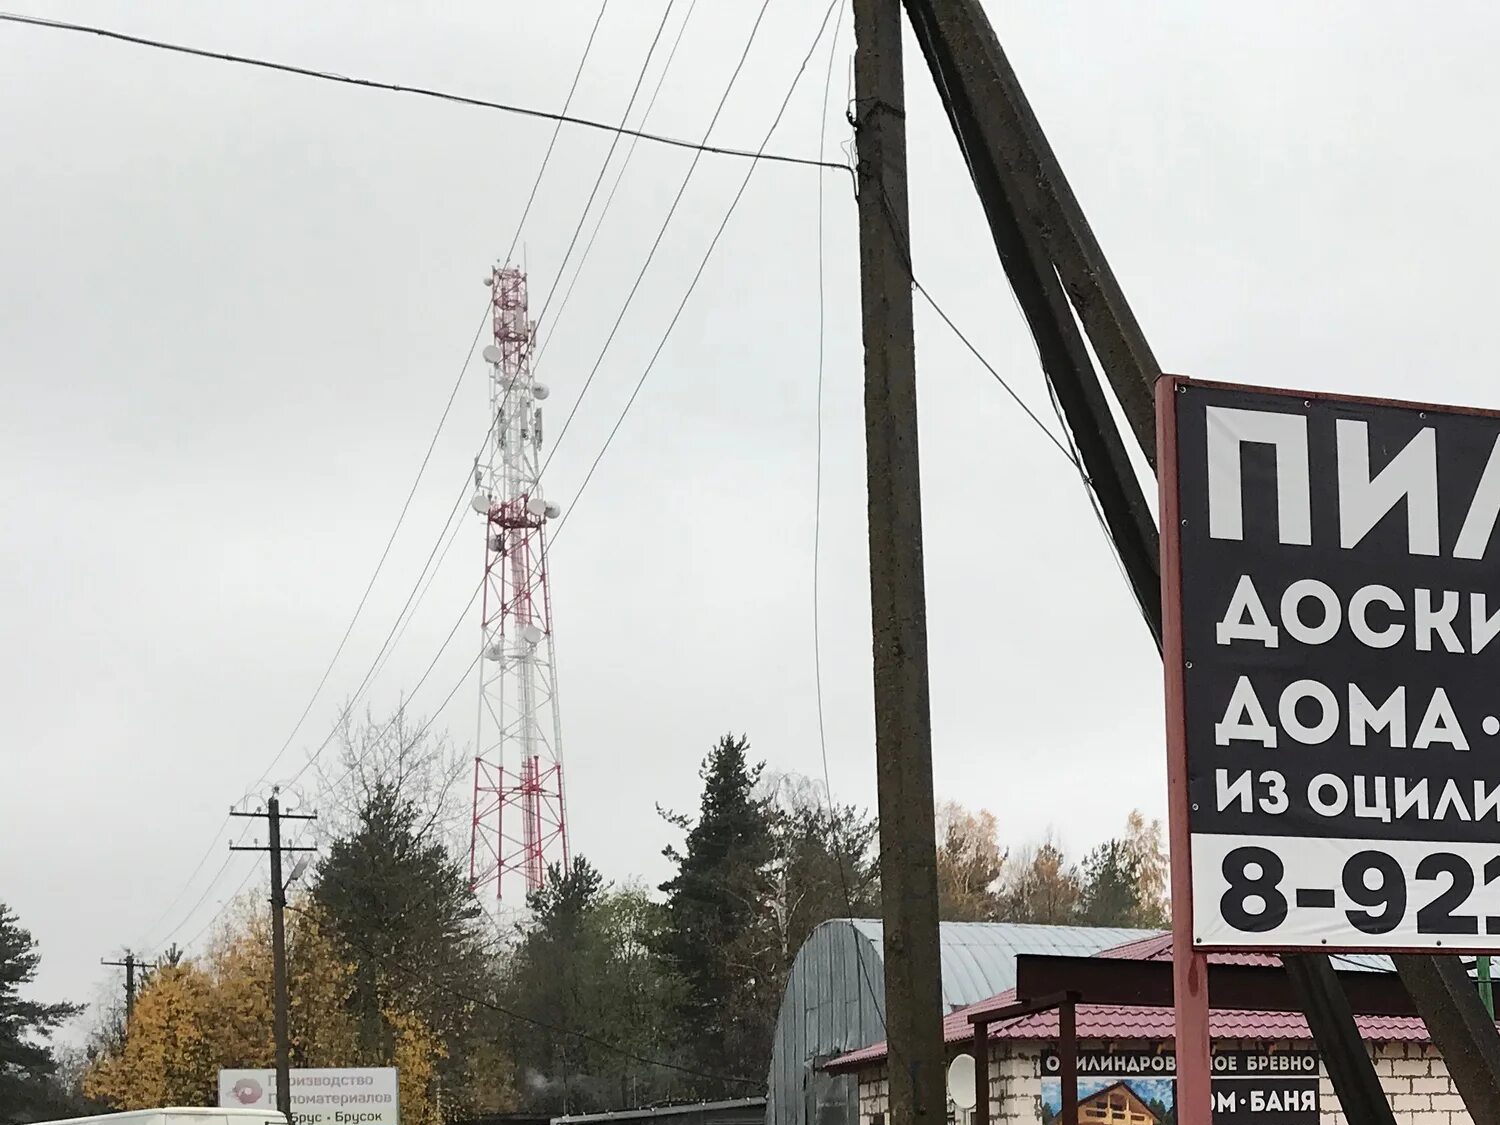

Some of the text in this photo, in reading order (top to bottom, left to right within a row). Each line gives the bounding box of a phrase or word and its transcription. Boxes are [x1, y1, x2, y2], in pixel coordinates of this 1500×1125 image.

[1215, 676, 1469, 750] ДОМА
[1216, 769, 1288, 814] ИЗ
[1247, 1056, 1315, 1071] БРЕВНО
[268, 1075, 373, 1087] Поизводство
[268, 1092, 392, 1106] Пломатериалов
[1250, 1090, 1316, 1112] БАНЯ
[335, 1111, 382, 1125] Брусок
